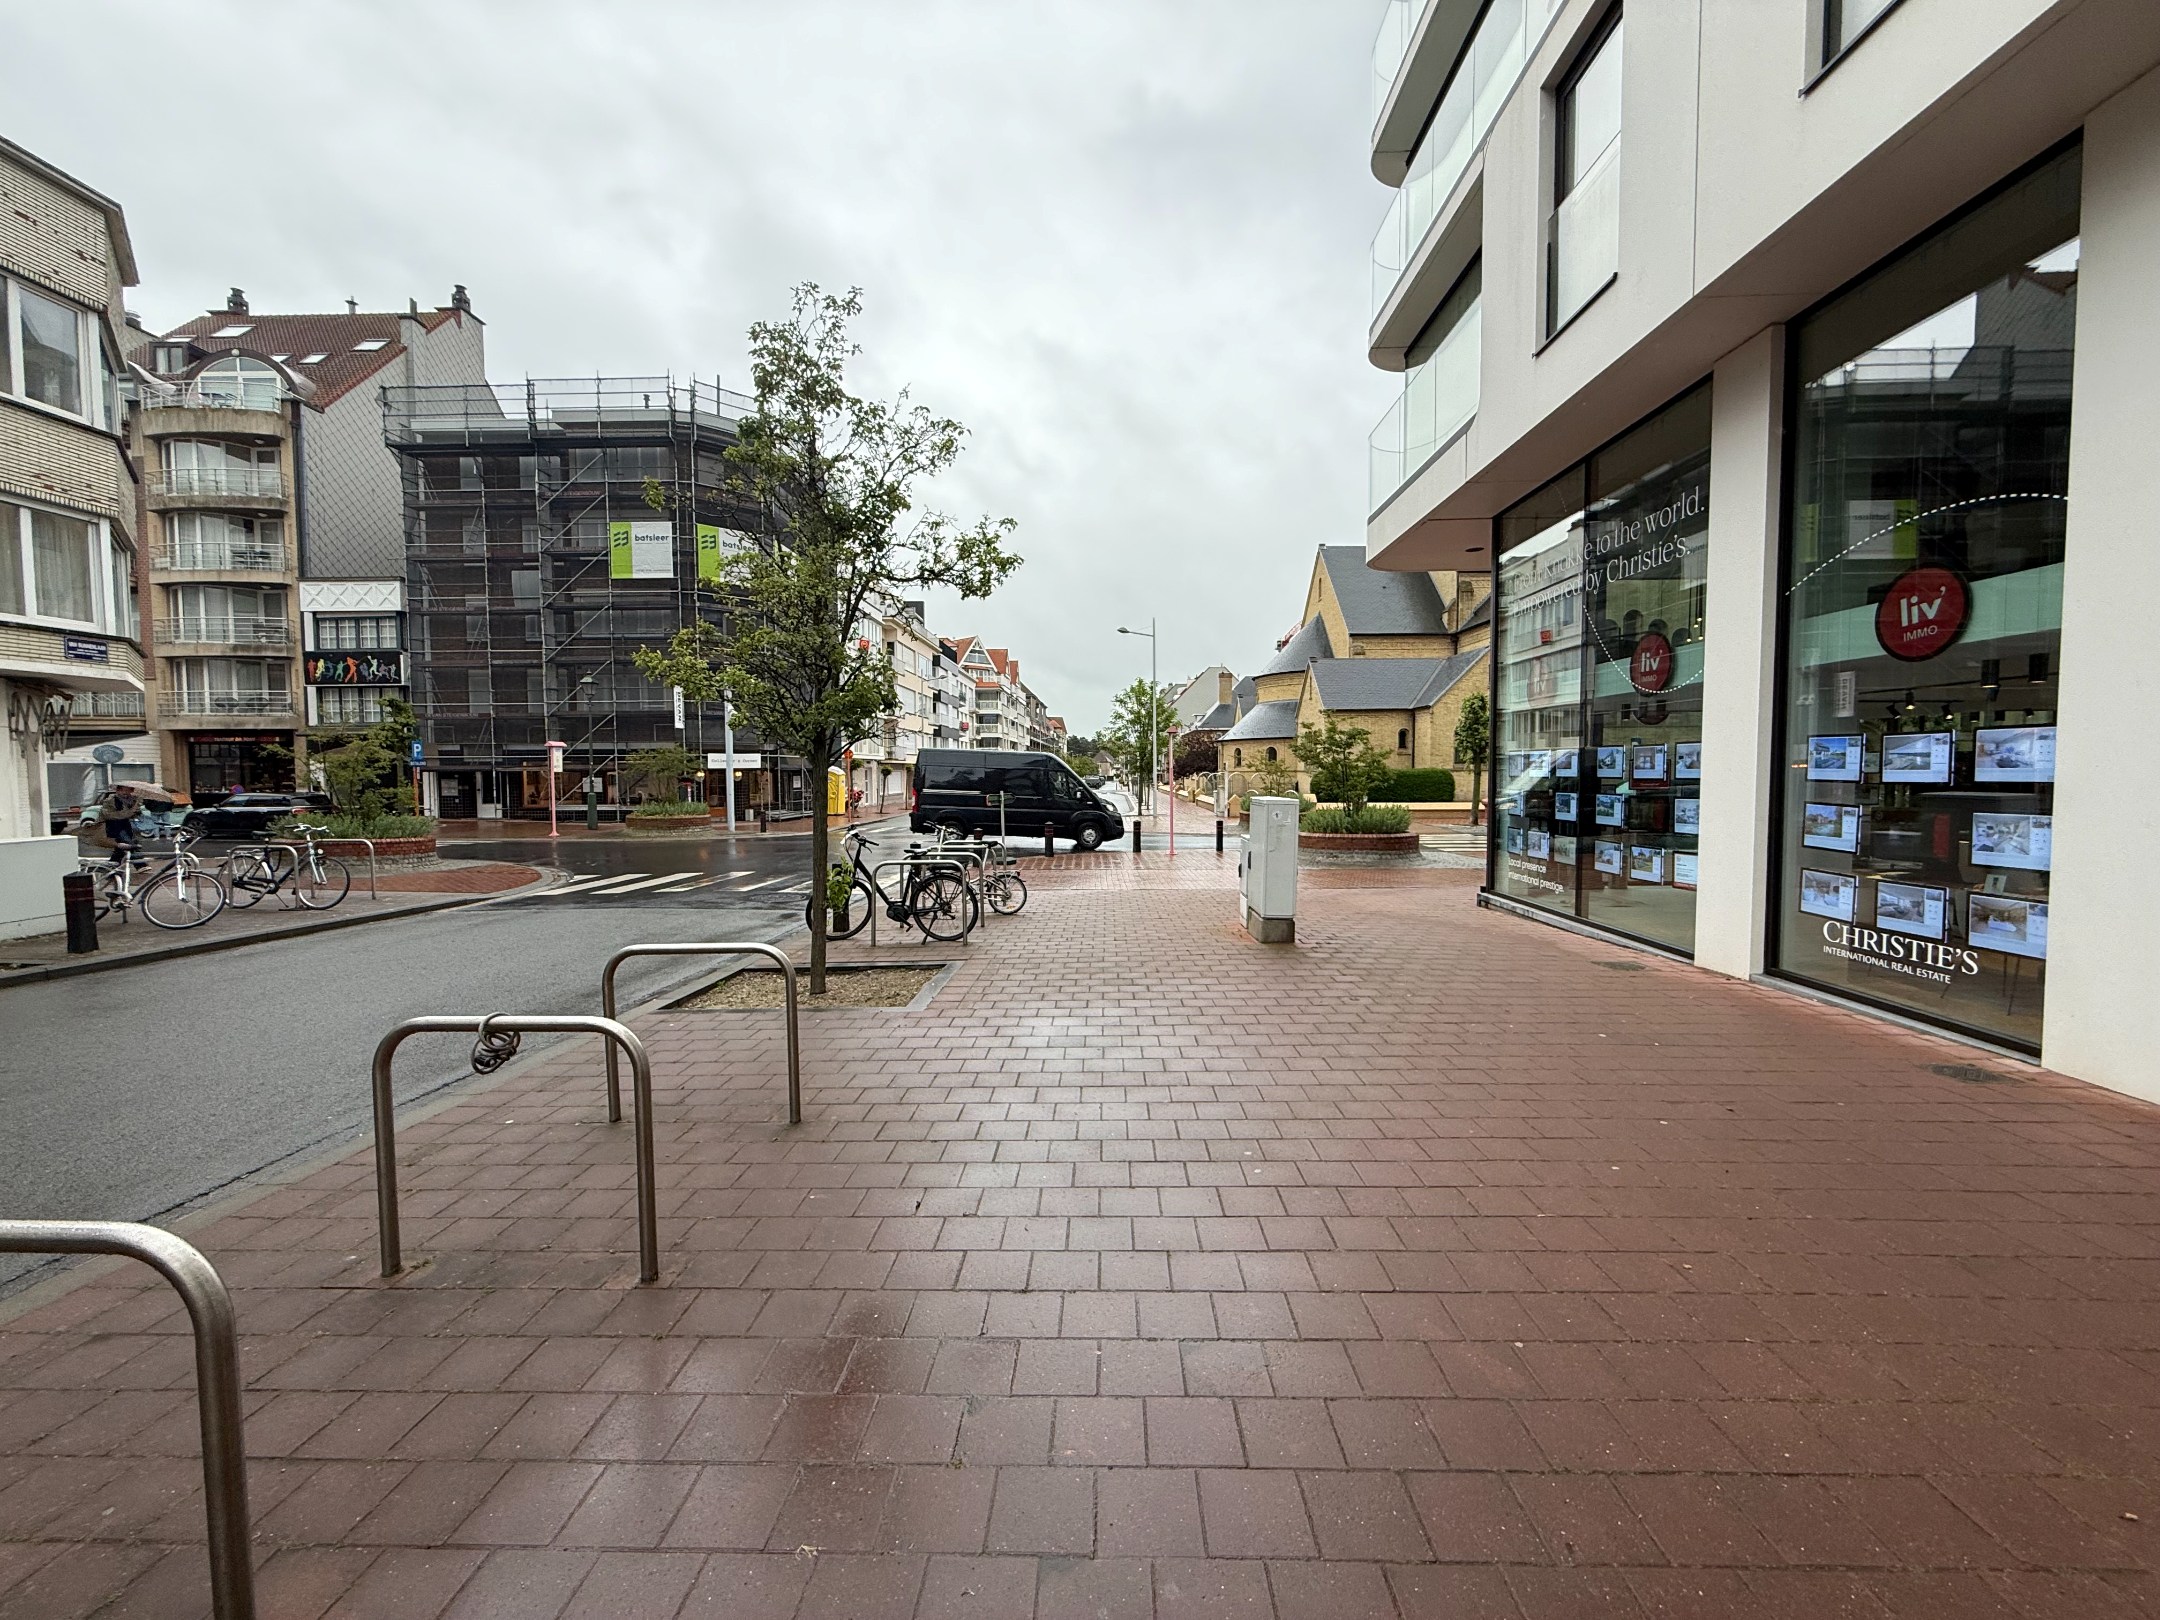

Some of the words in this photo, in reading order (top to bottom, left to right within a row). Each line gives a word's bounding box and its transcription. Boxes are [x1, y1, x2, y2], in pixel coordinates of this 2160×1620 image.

[1596, 535, 1610, 555] to
[1614, 521, 1640, 548] the
[1645, 486, 1705, 534] world.
[634, 533, 670, 542] batsleer
[1513, 573, 1581, 617] Empowered
[1586, 569, 1604, 594] by
[1903, 625, 1937, 642] IMMO
[413, 743, 422, 757] P
[1522, 861, 1547, 873] presence
[1540, 880, 1564, 894] prestige.
[1823, 945, 1889, 969] INTERNATIONAL
[1891, 961, 1914, 975] REAL
[1916, 968, 1951, 984] ESTATE
